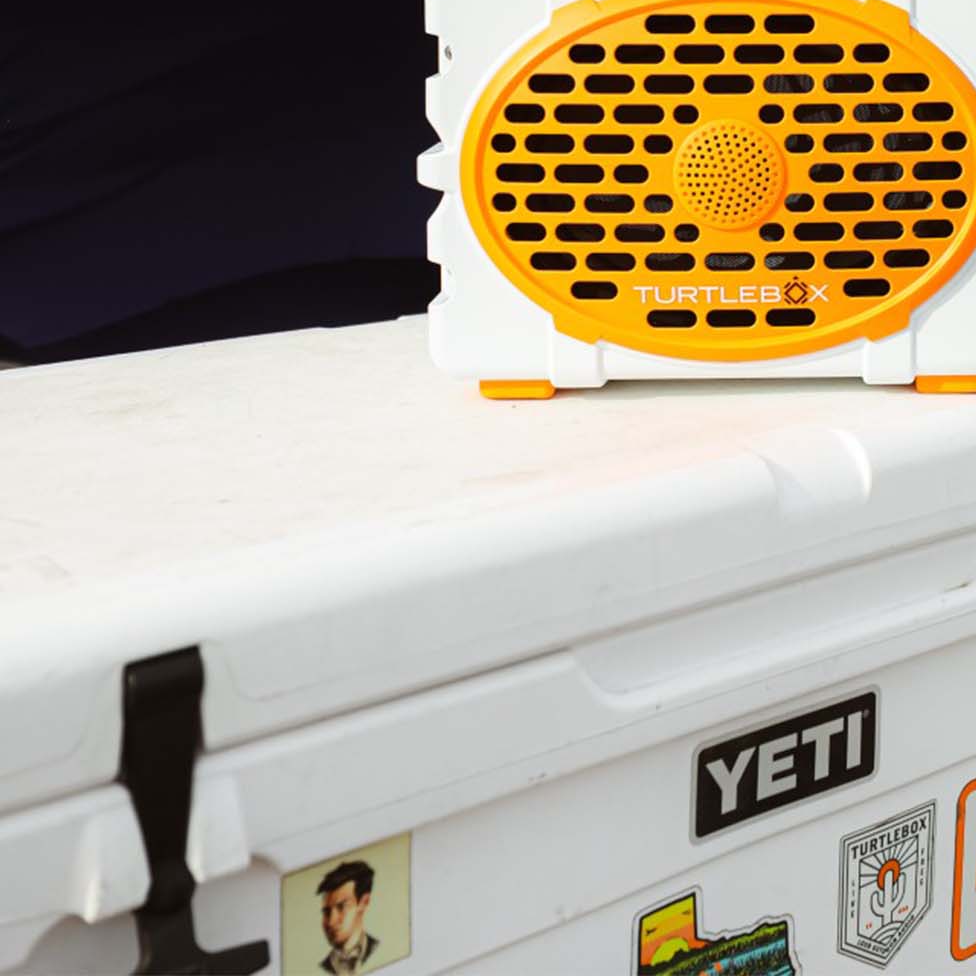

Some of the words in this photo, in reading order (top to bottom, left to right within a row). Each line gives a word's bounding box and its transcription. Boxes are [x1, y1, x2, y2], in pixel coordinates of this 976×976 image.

[633, 276, 829, 304] TURTLEBOX
[705, 710, 863, 815] YETI
[851, 816, 927, 860] TURTLEBOX
